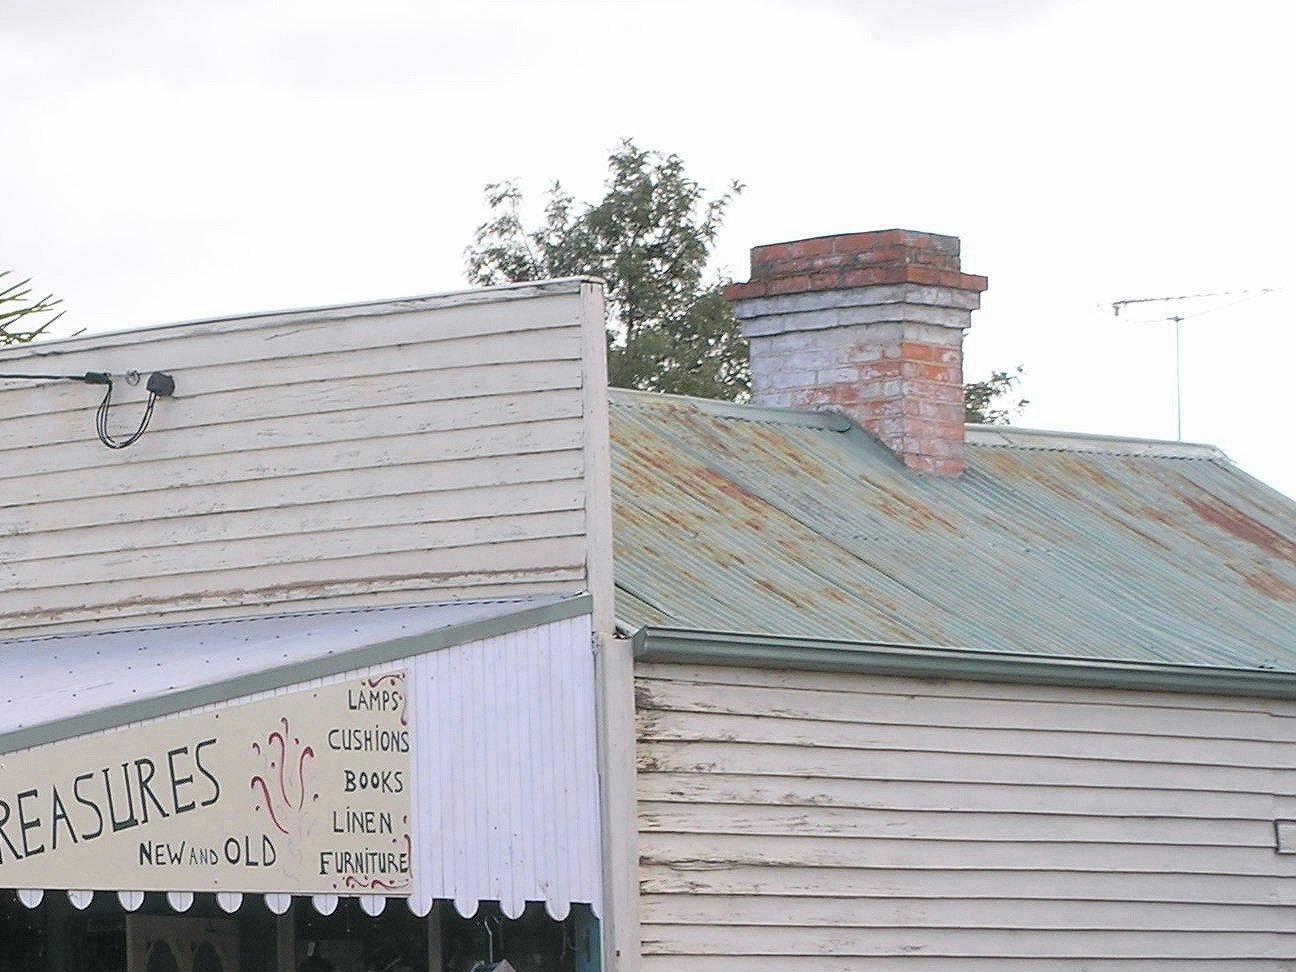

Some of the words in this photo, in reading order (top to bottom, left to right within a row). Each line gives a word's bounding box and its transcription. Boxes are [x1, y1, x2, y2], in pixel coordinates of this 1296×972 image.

[347, 689, 399, 711] LAMPS
[327, 724, 410, 753] CUSHIONS
[343, 769, 404, 794] BOOKS
[332, 805, 393, 834] LINEN
[138, 840, 186, 866] NEW
[188, 847, 219, 866] AND
[223, 833, 277, 867] OLD
[319, 847, 409, 875] FURNITURE
